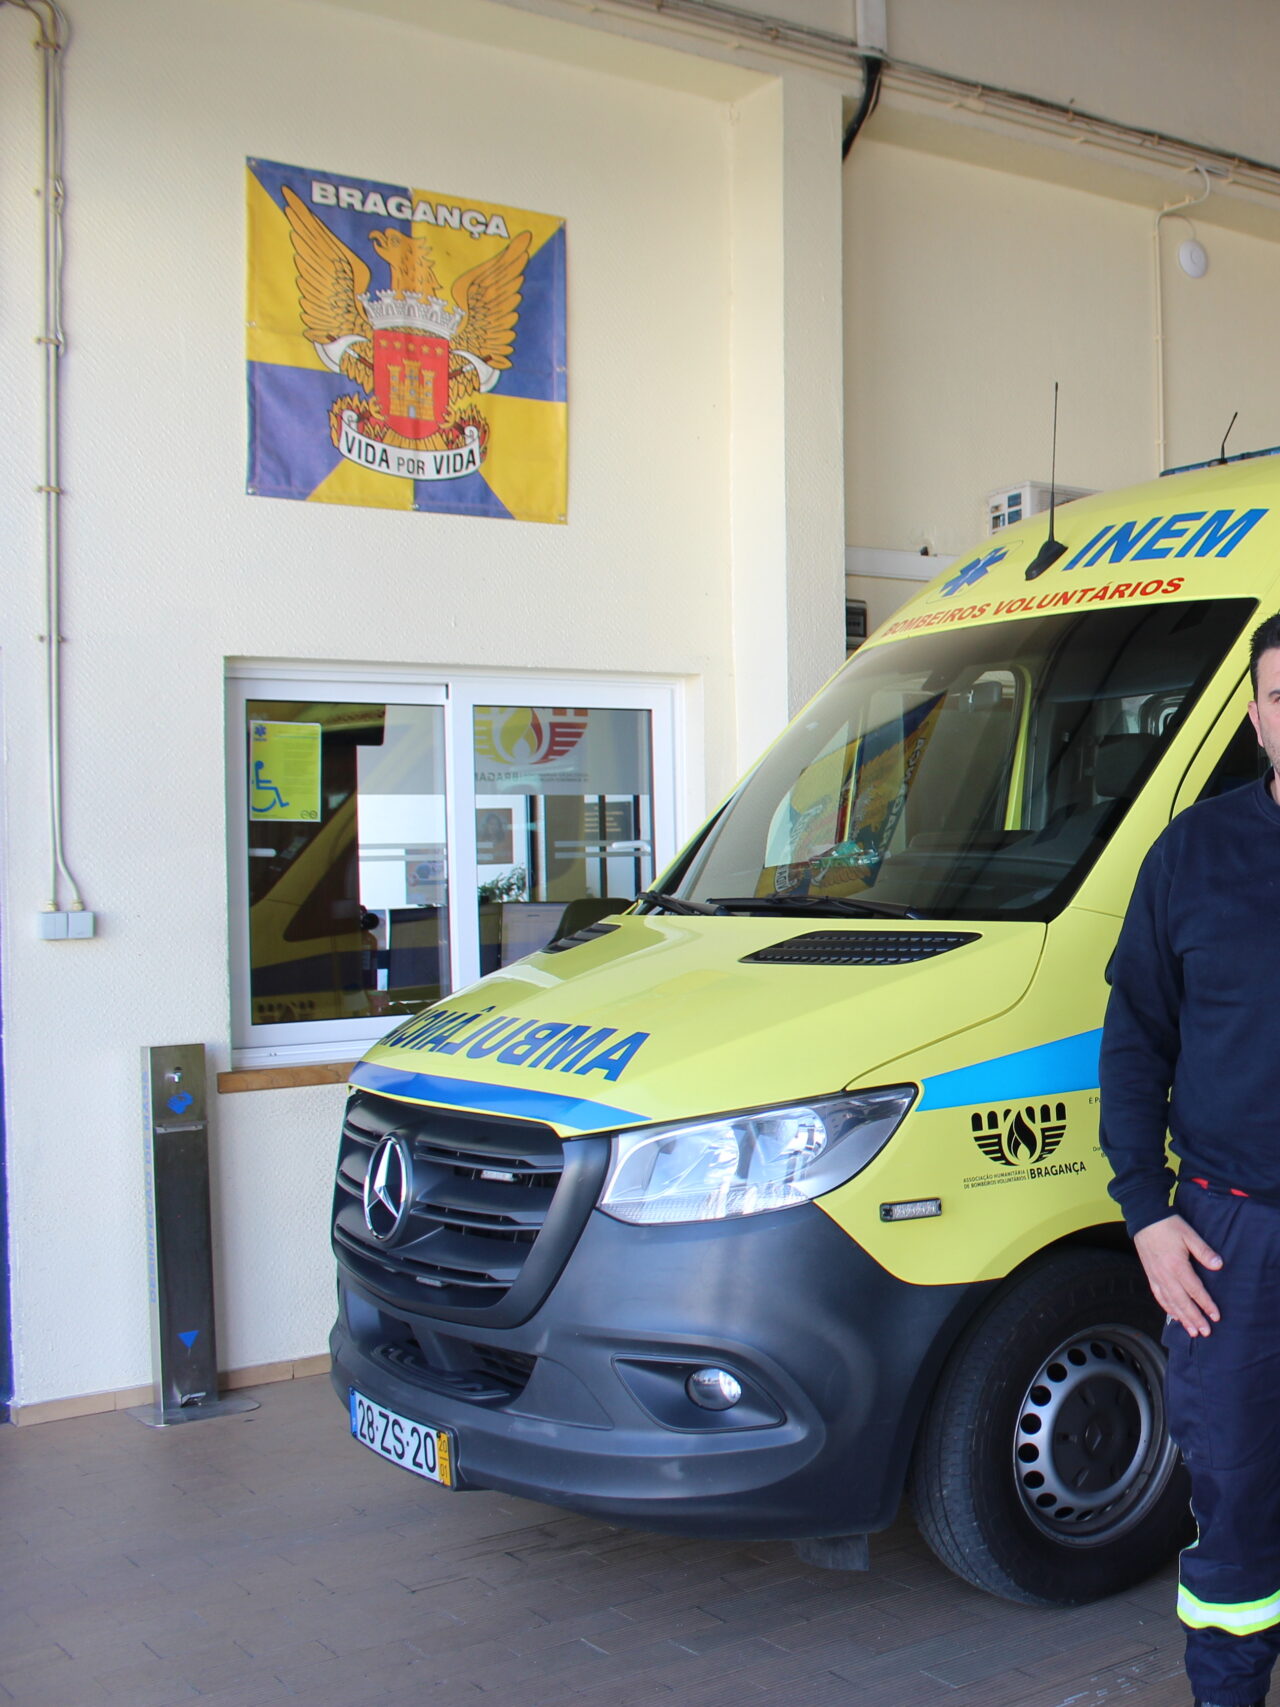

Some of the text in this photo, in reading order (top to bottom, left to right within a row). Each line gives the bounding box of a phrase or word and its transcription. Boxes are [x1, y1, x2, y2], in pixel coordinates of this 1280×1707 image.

[311, 180, 510, 239] BRAGANÇA
[344, 430, 477, 476] VIDA POR VIDA
[1063, 508, 1269, 571] INEM
[882, 576, 1185, 638] BOMBEIROS VOLUNTÁRIOS
[1029, 1161, 1087, 1179] BRAGANÇA
